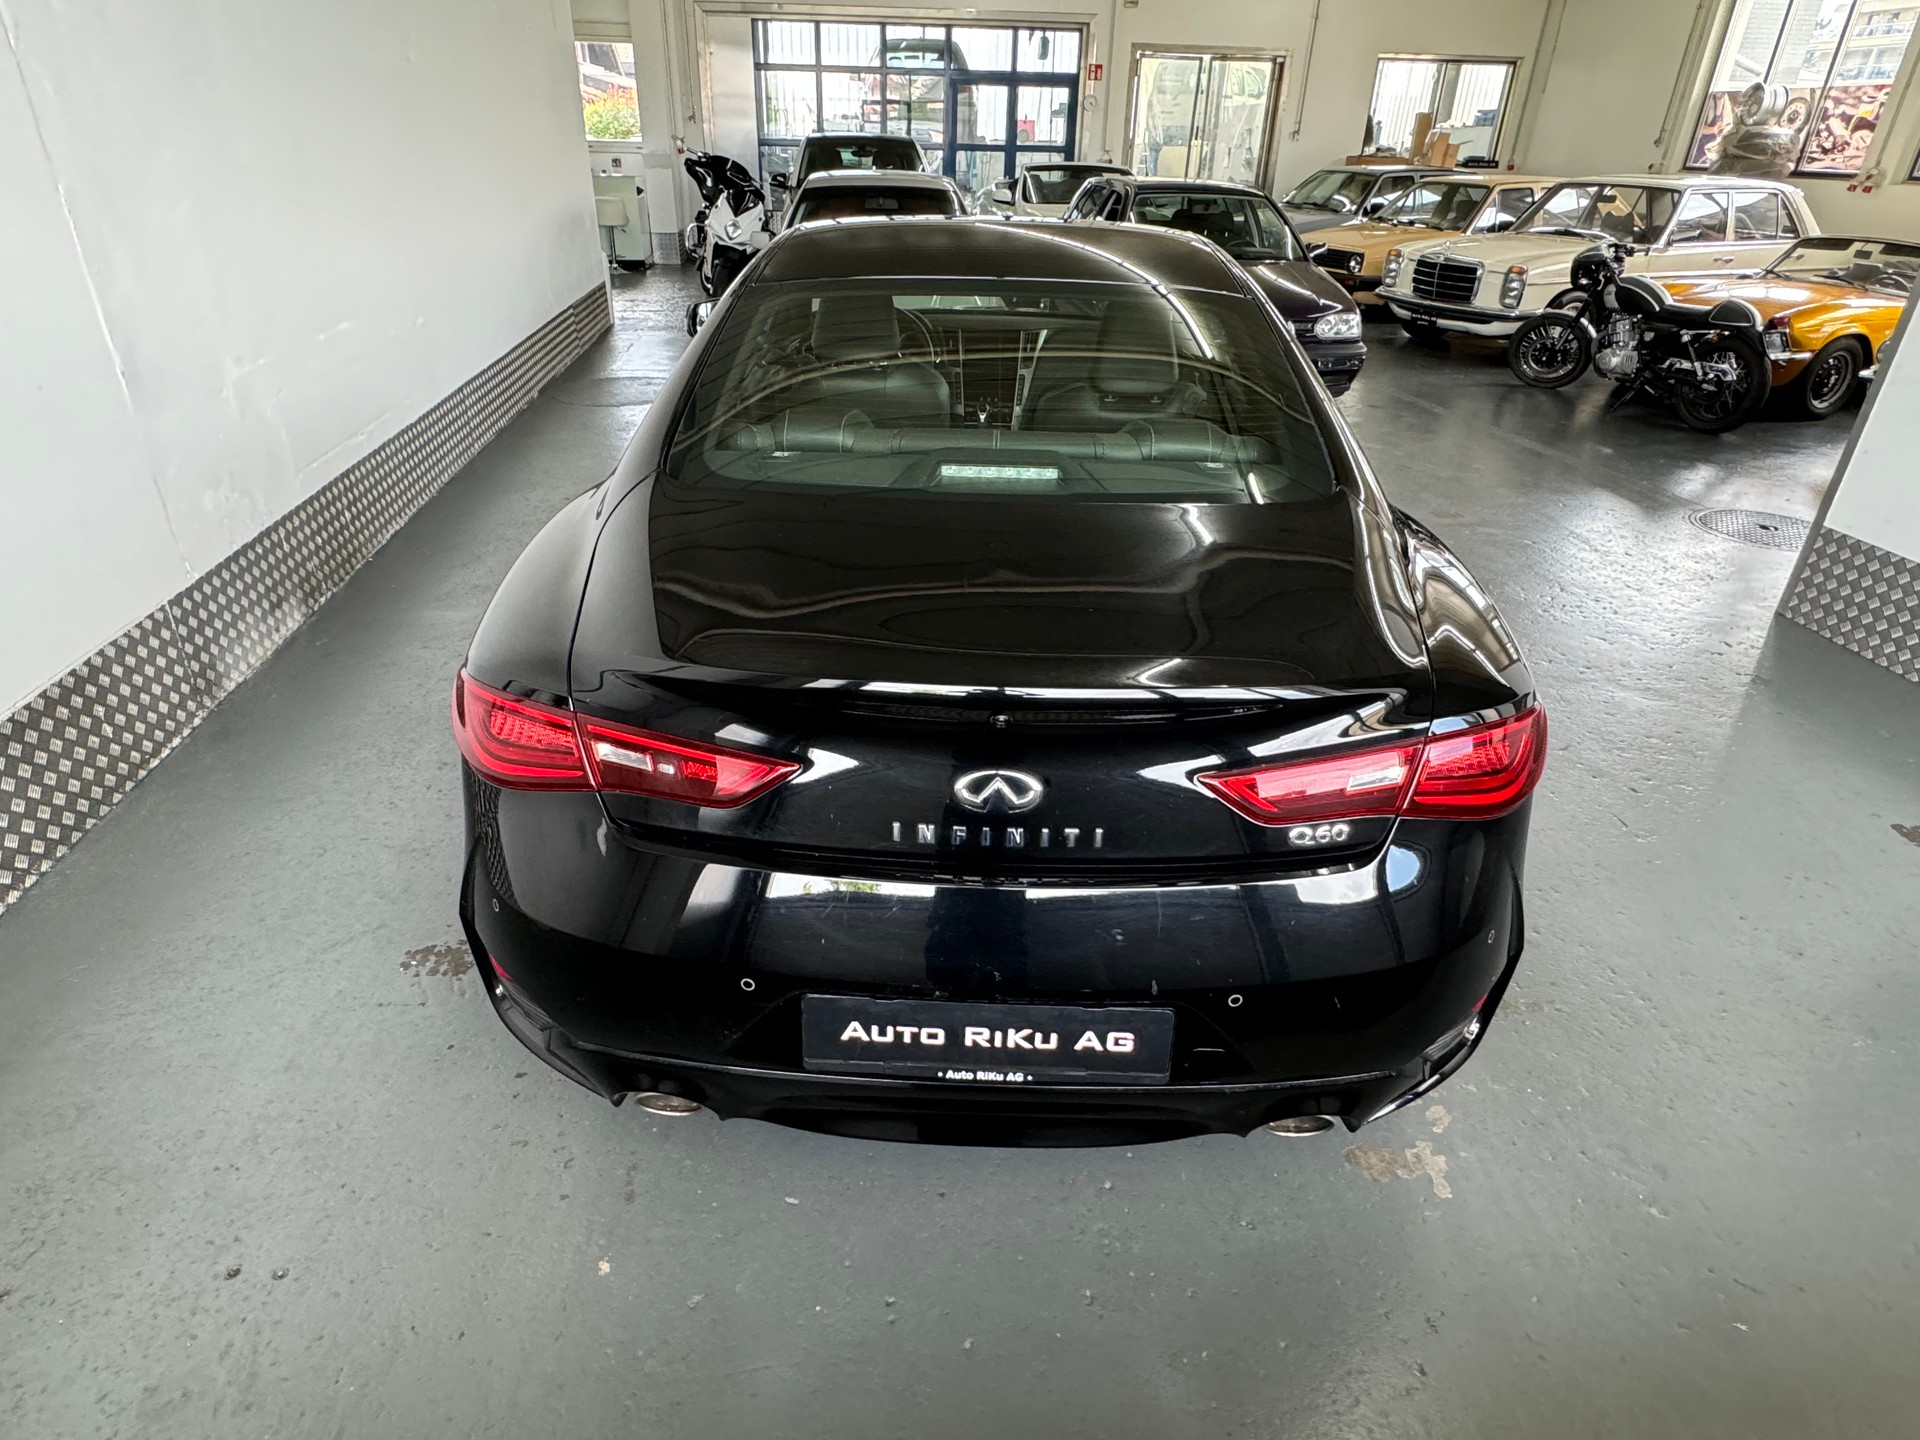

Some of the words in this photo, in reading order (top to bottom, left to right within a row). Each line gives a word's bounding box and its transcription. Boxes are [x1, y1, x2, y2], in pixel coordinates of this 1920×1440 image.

[891, 821, 1105, 849] INFINITI
[1288, 823, 1351, 845] Q60
[1073, 1030, 1137, 1053] AG
[945, 1069, 975, 1080] Auto
[976, 1070, 1005, 1081] RiKu
[1005, 1071, 1025, 1082] AG
